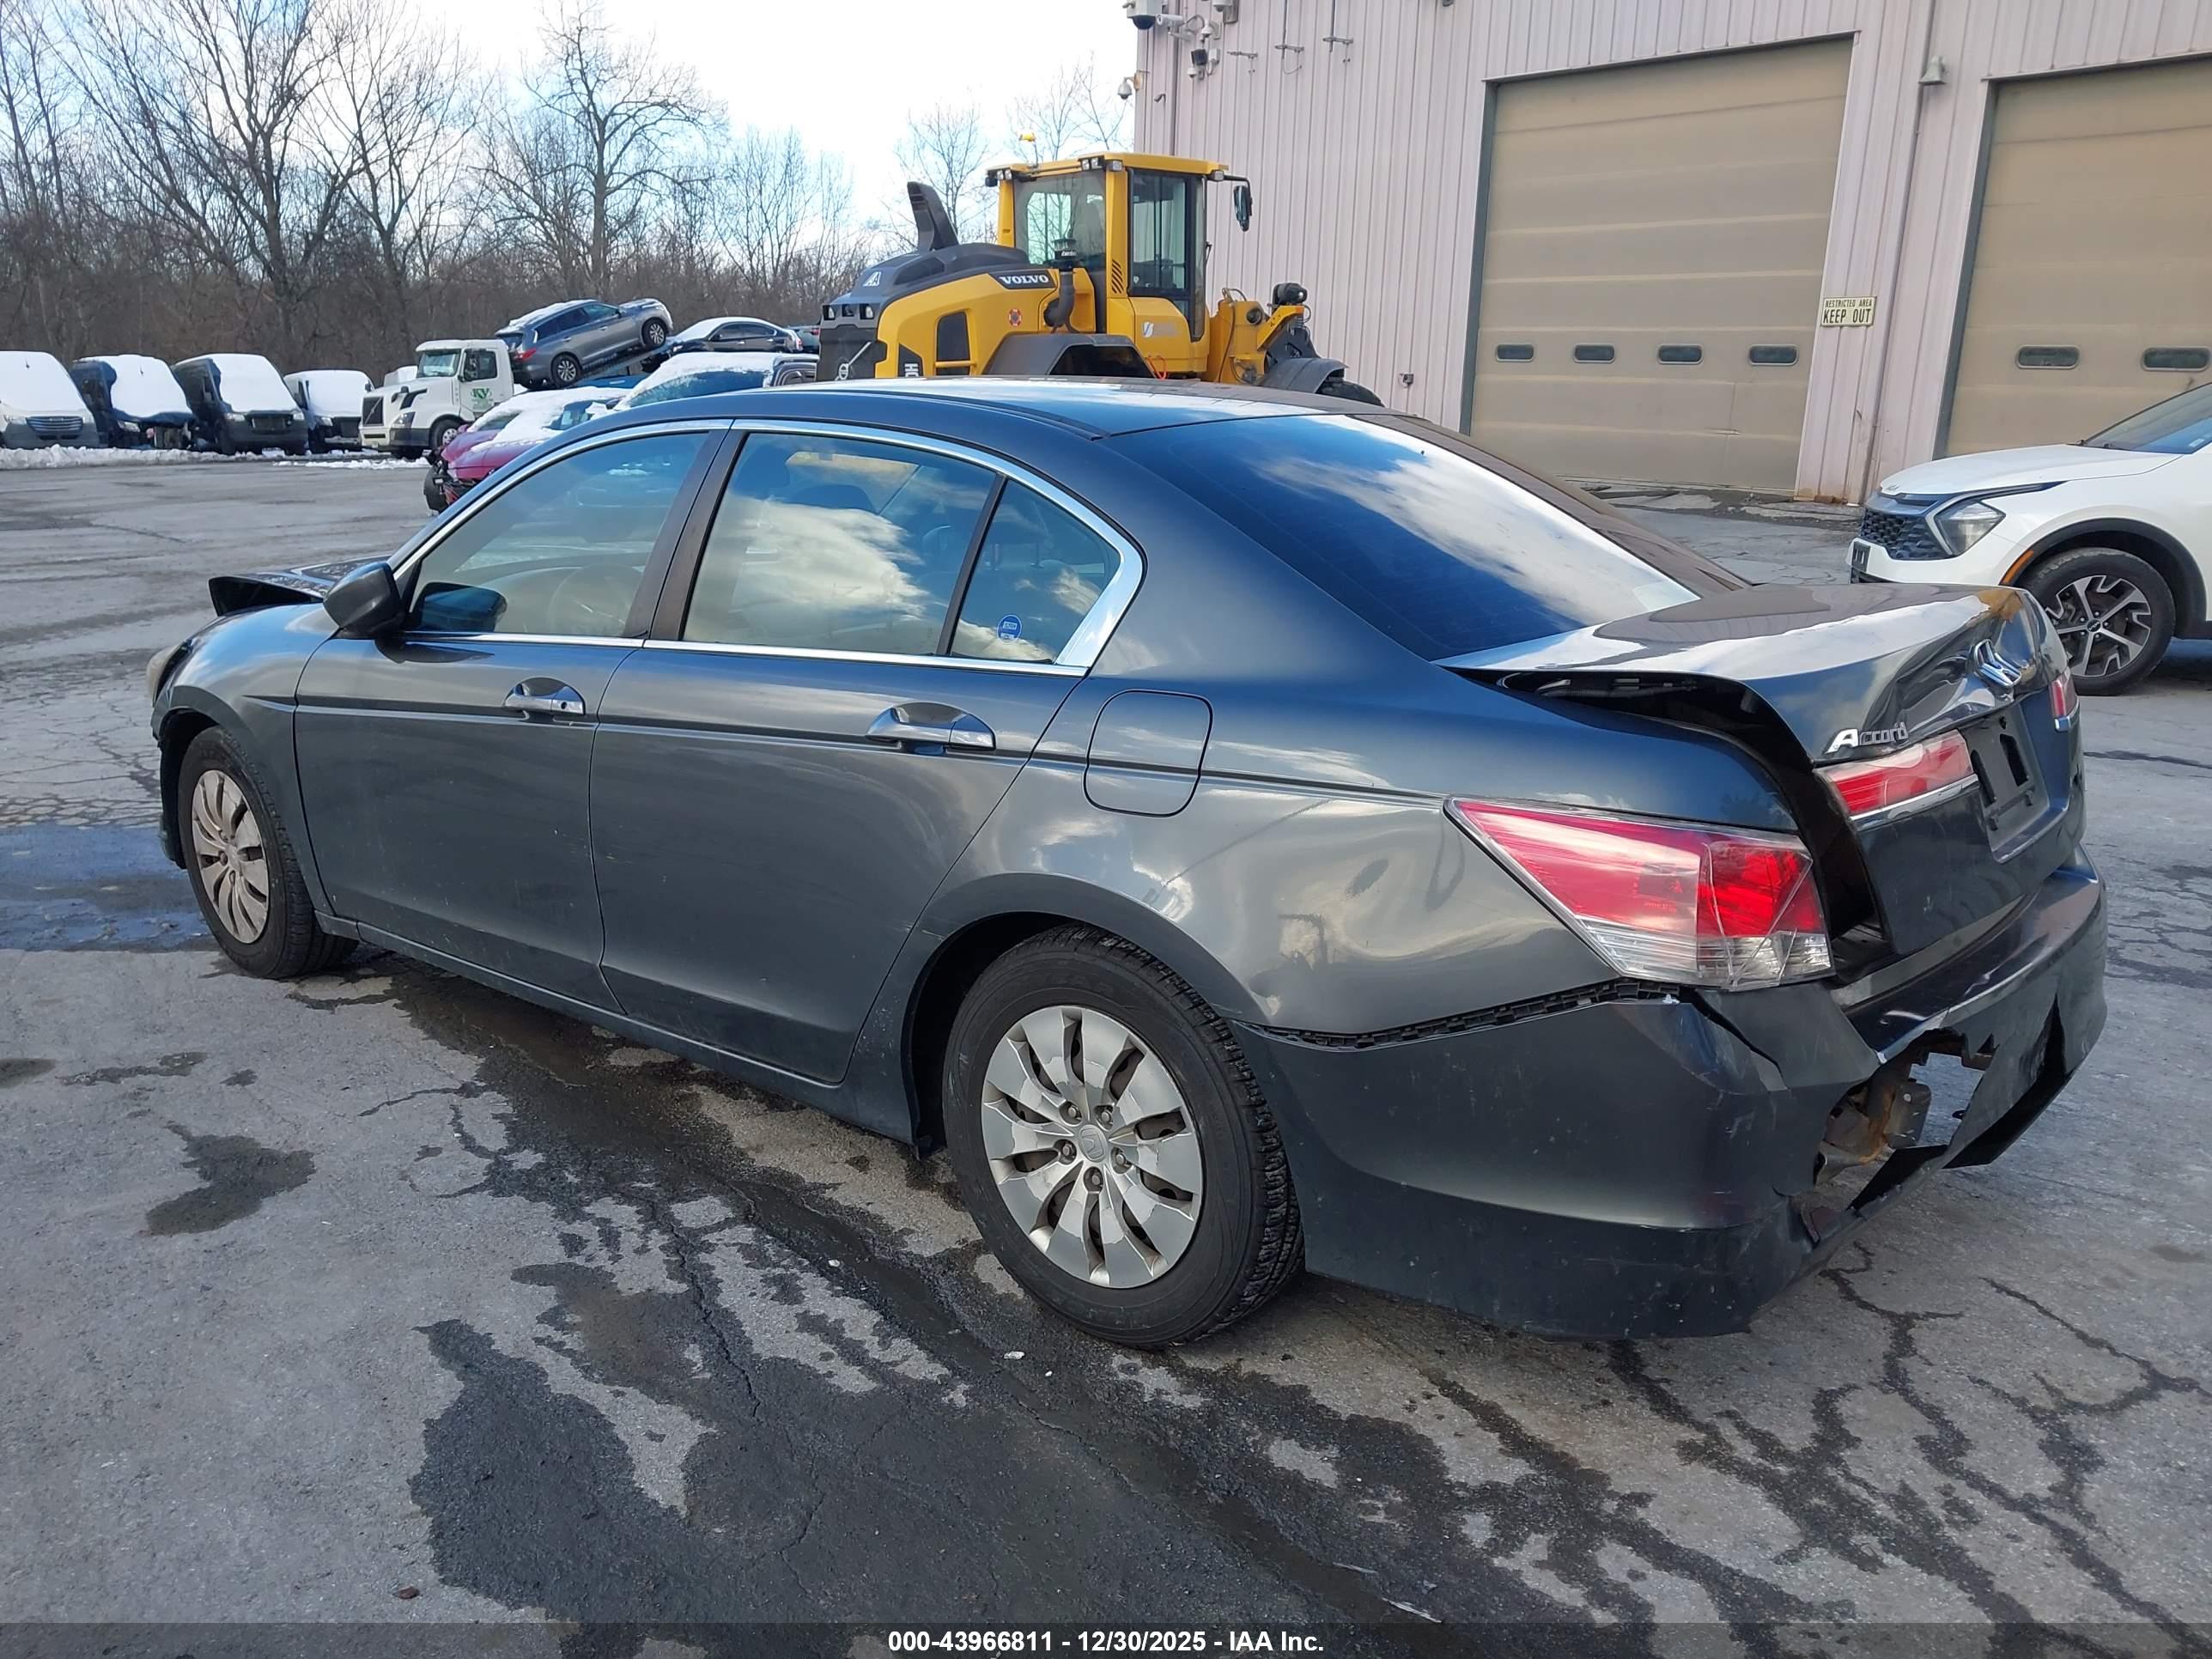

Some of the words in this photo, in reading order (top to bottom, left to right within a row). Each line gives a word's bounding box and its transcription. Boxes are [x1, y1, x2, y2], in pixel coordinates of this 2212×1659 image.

[999, 274, 1049, 284] VOLVO
[1825, 299, 1856, 308] RESTRICTED
[1858, 298, 1872, 307] AREA
[1823, 308, 1847, 324] KEEP
[1852, 308, 1872, 323] OUT
[1824, 720, 1909, 755] Accord
